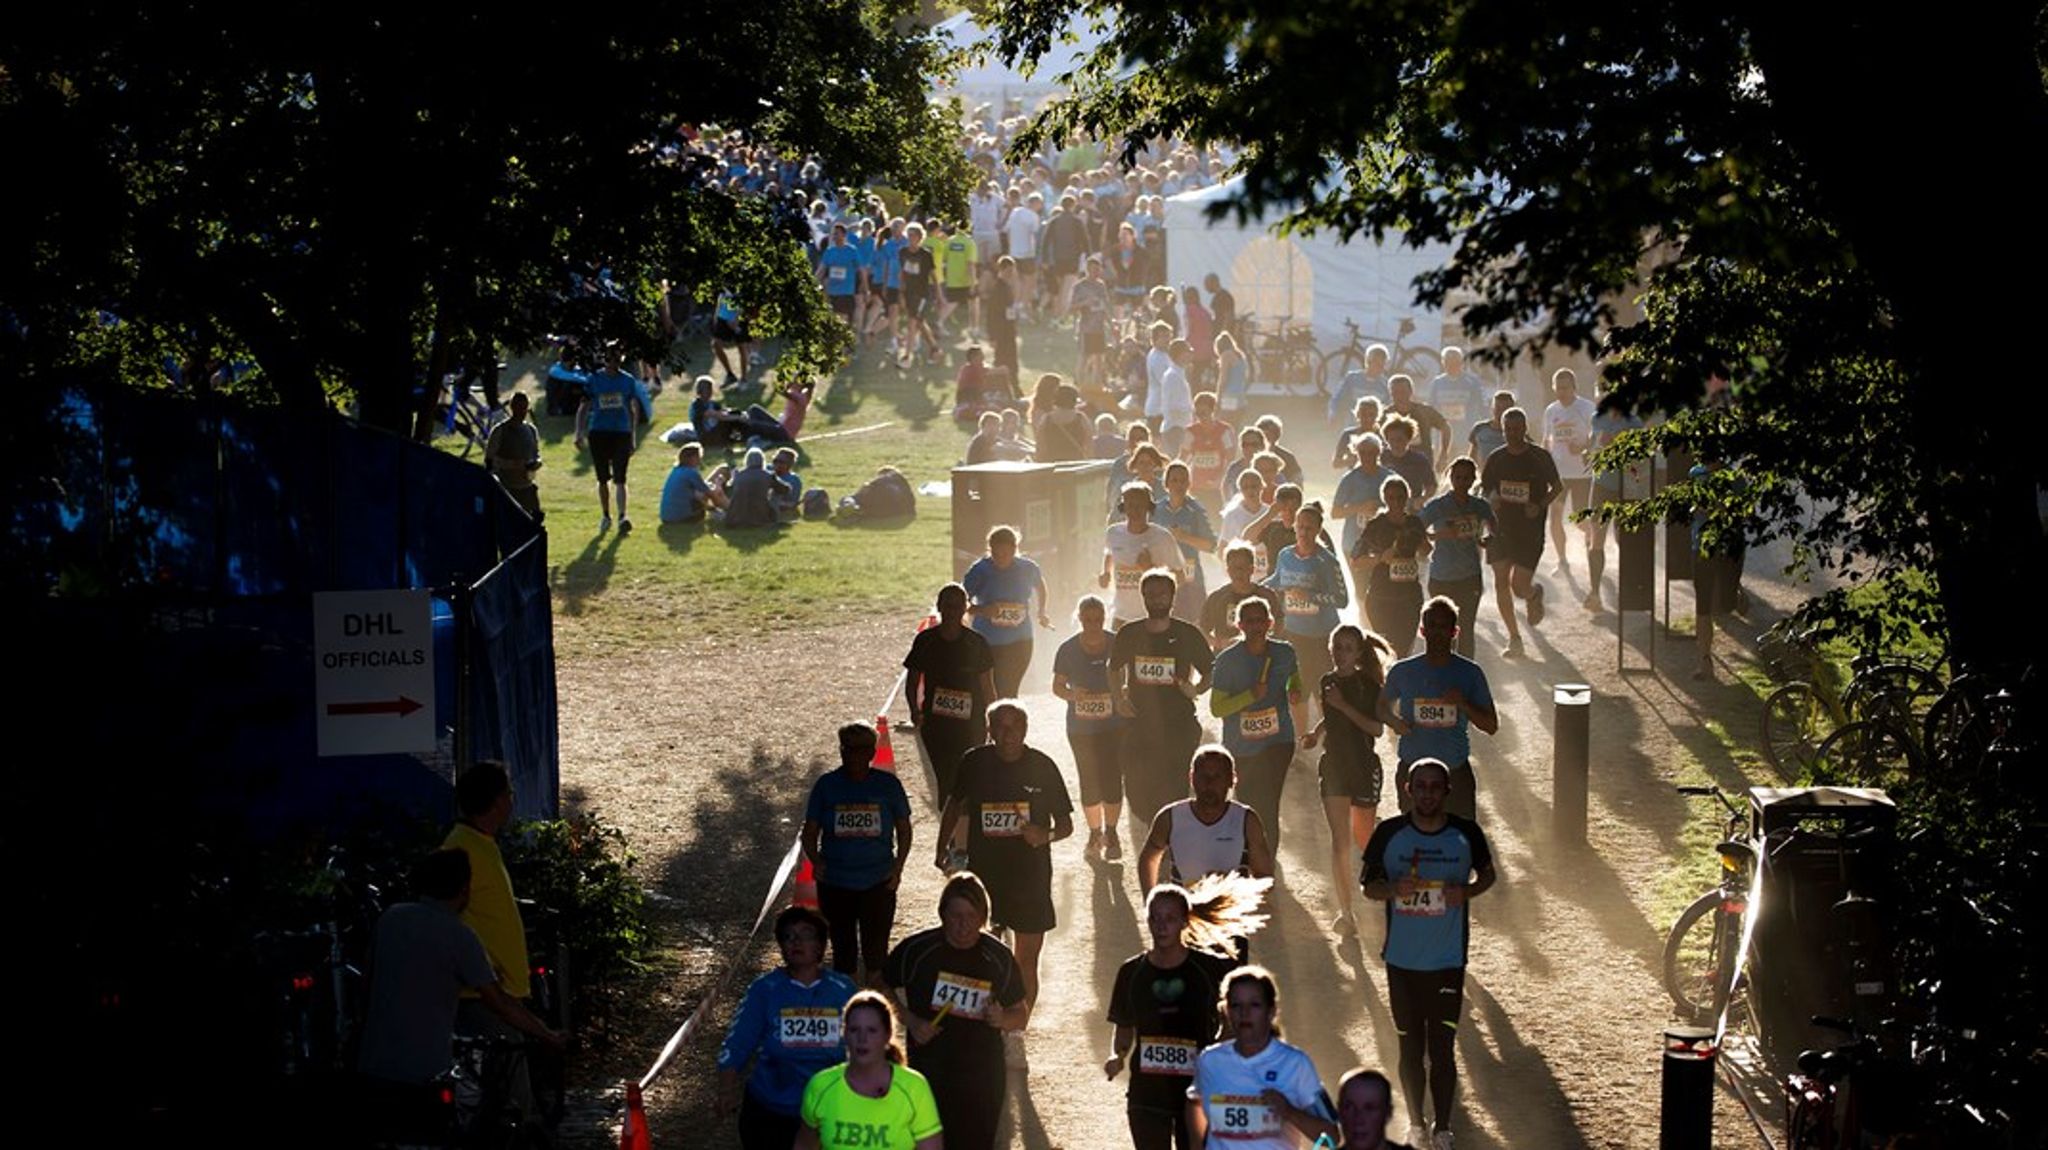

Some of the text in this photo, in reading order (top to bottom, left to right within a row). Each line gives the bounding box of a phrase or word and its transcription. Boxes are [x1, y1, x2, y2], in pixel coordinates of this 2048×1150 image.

[344, 613, 403, 636] DHL
[323, 650, 425, 669] OFFICIALS
[1140, 664, 1164, 678] 440
[1419, 706, 1445, 721] 894
[837, 811, 873, 828] 4826
[984, 812, 1019, 828] 5277
[936, 987, 981, 1008] 4711
[783, 1018, 828, 1037] 3249
[1143, 1045, 1188, 1065] 4588
[1224, 1107, 1249, 1128] 58
[831, 1120, 892, 1149] IBM
